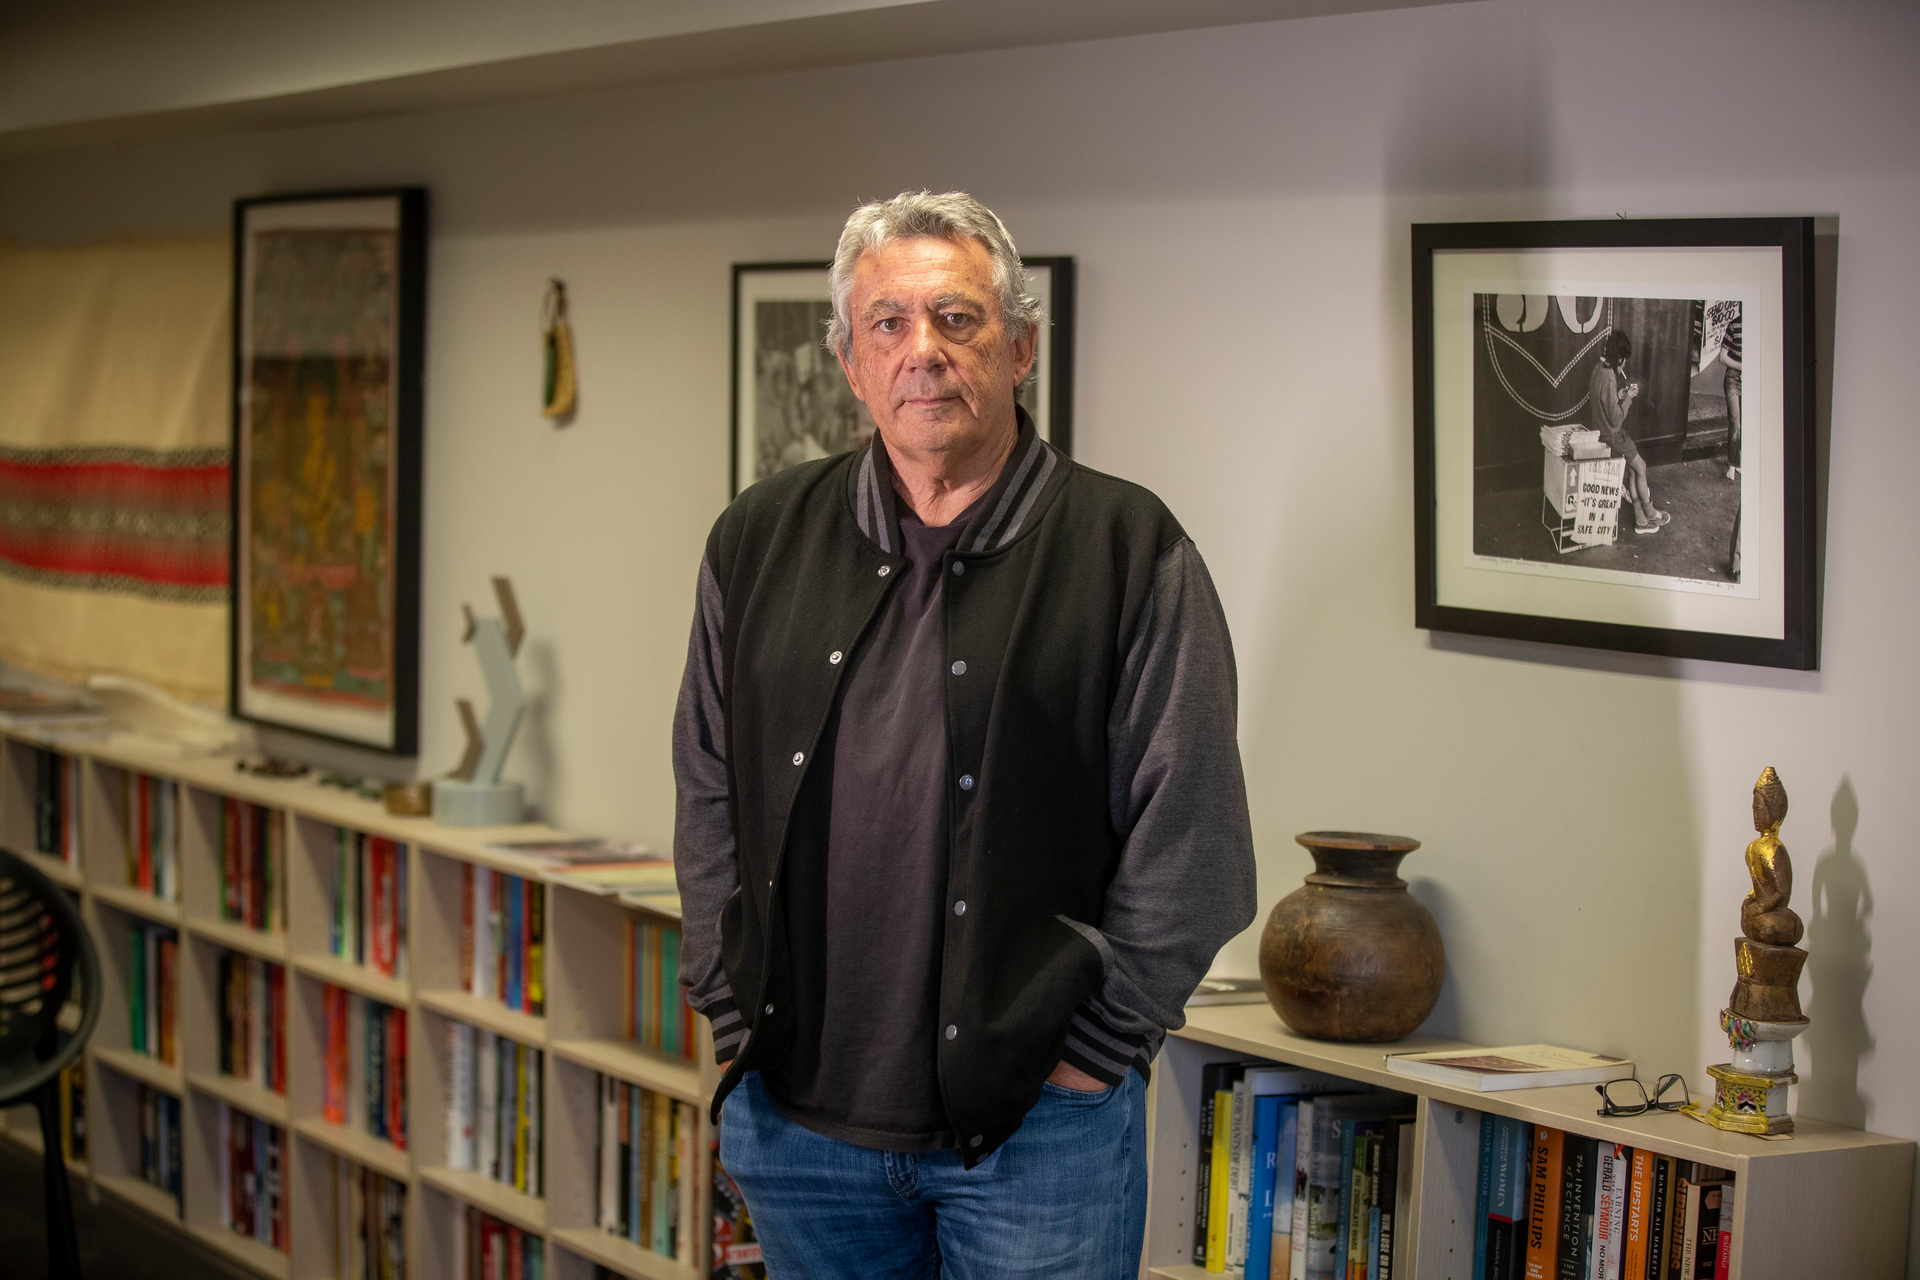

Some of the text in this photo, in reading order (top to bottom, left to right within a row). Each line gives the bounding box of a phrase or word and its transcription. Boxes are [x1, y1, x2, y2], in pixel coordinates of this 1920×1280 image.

[1583, 483, 1619, 496] GOOD NEWS
[1598, 500, 1617, 509] GREAT
[1577, 525, 1611, 534] SAFE CITY
[1589, 513, 1604, 521] IN A
[1230, 1092, 1244, 1192] MERCHANTS OF DEBT
[1481, 1164, 1490, 1197] DOOR
[1497, 1163, 1508, 1208] WOMEN
[1634, 1155, 1644, 1178] THE
[1352, 1189, 1360, 1228] CHOCOLATE
[1530, 1146, 1548, 1249] SAM PHILLIPS
[1563, 1166, 1573, 1240] of SCIENCE
[1571, 1178, 1582, 1256] INVENTION
[1598, 1156, 1613, 1240] GERALD SEYMOUR
[1613, 1188, 1623, 1234] EARNING
[1629, 1181, 1641, 1242] UPSTARTS
[1379, 1214, 1390, 1280] WIN, LOSE OR DR
[1599, 1245, 1606, 1257] NO
[1721, 1235, 1729, 1269] WAITANGI
